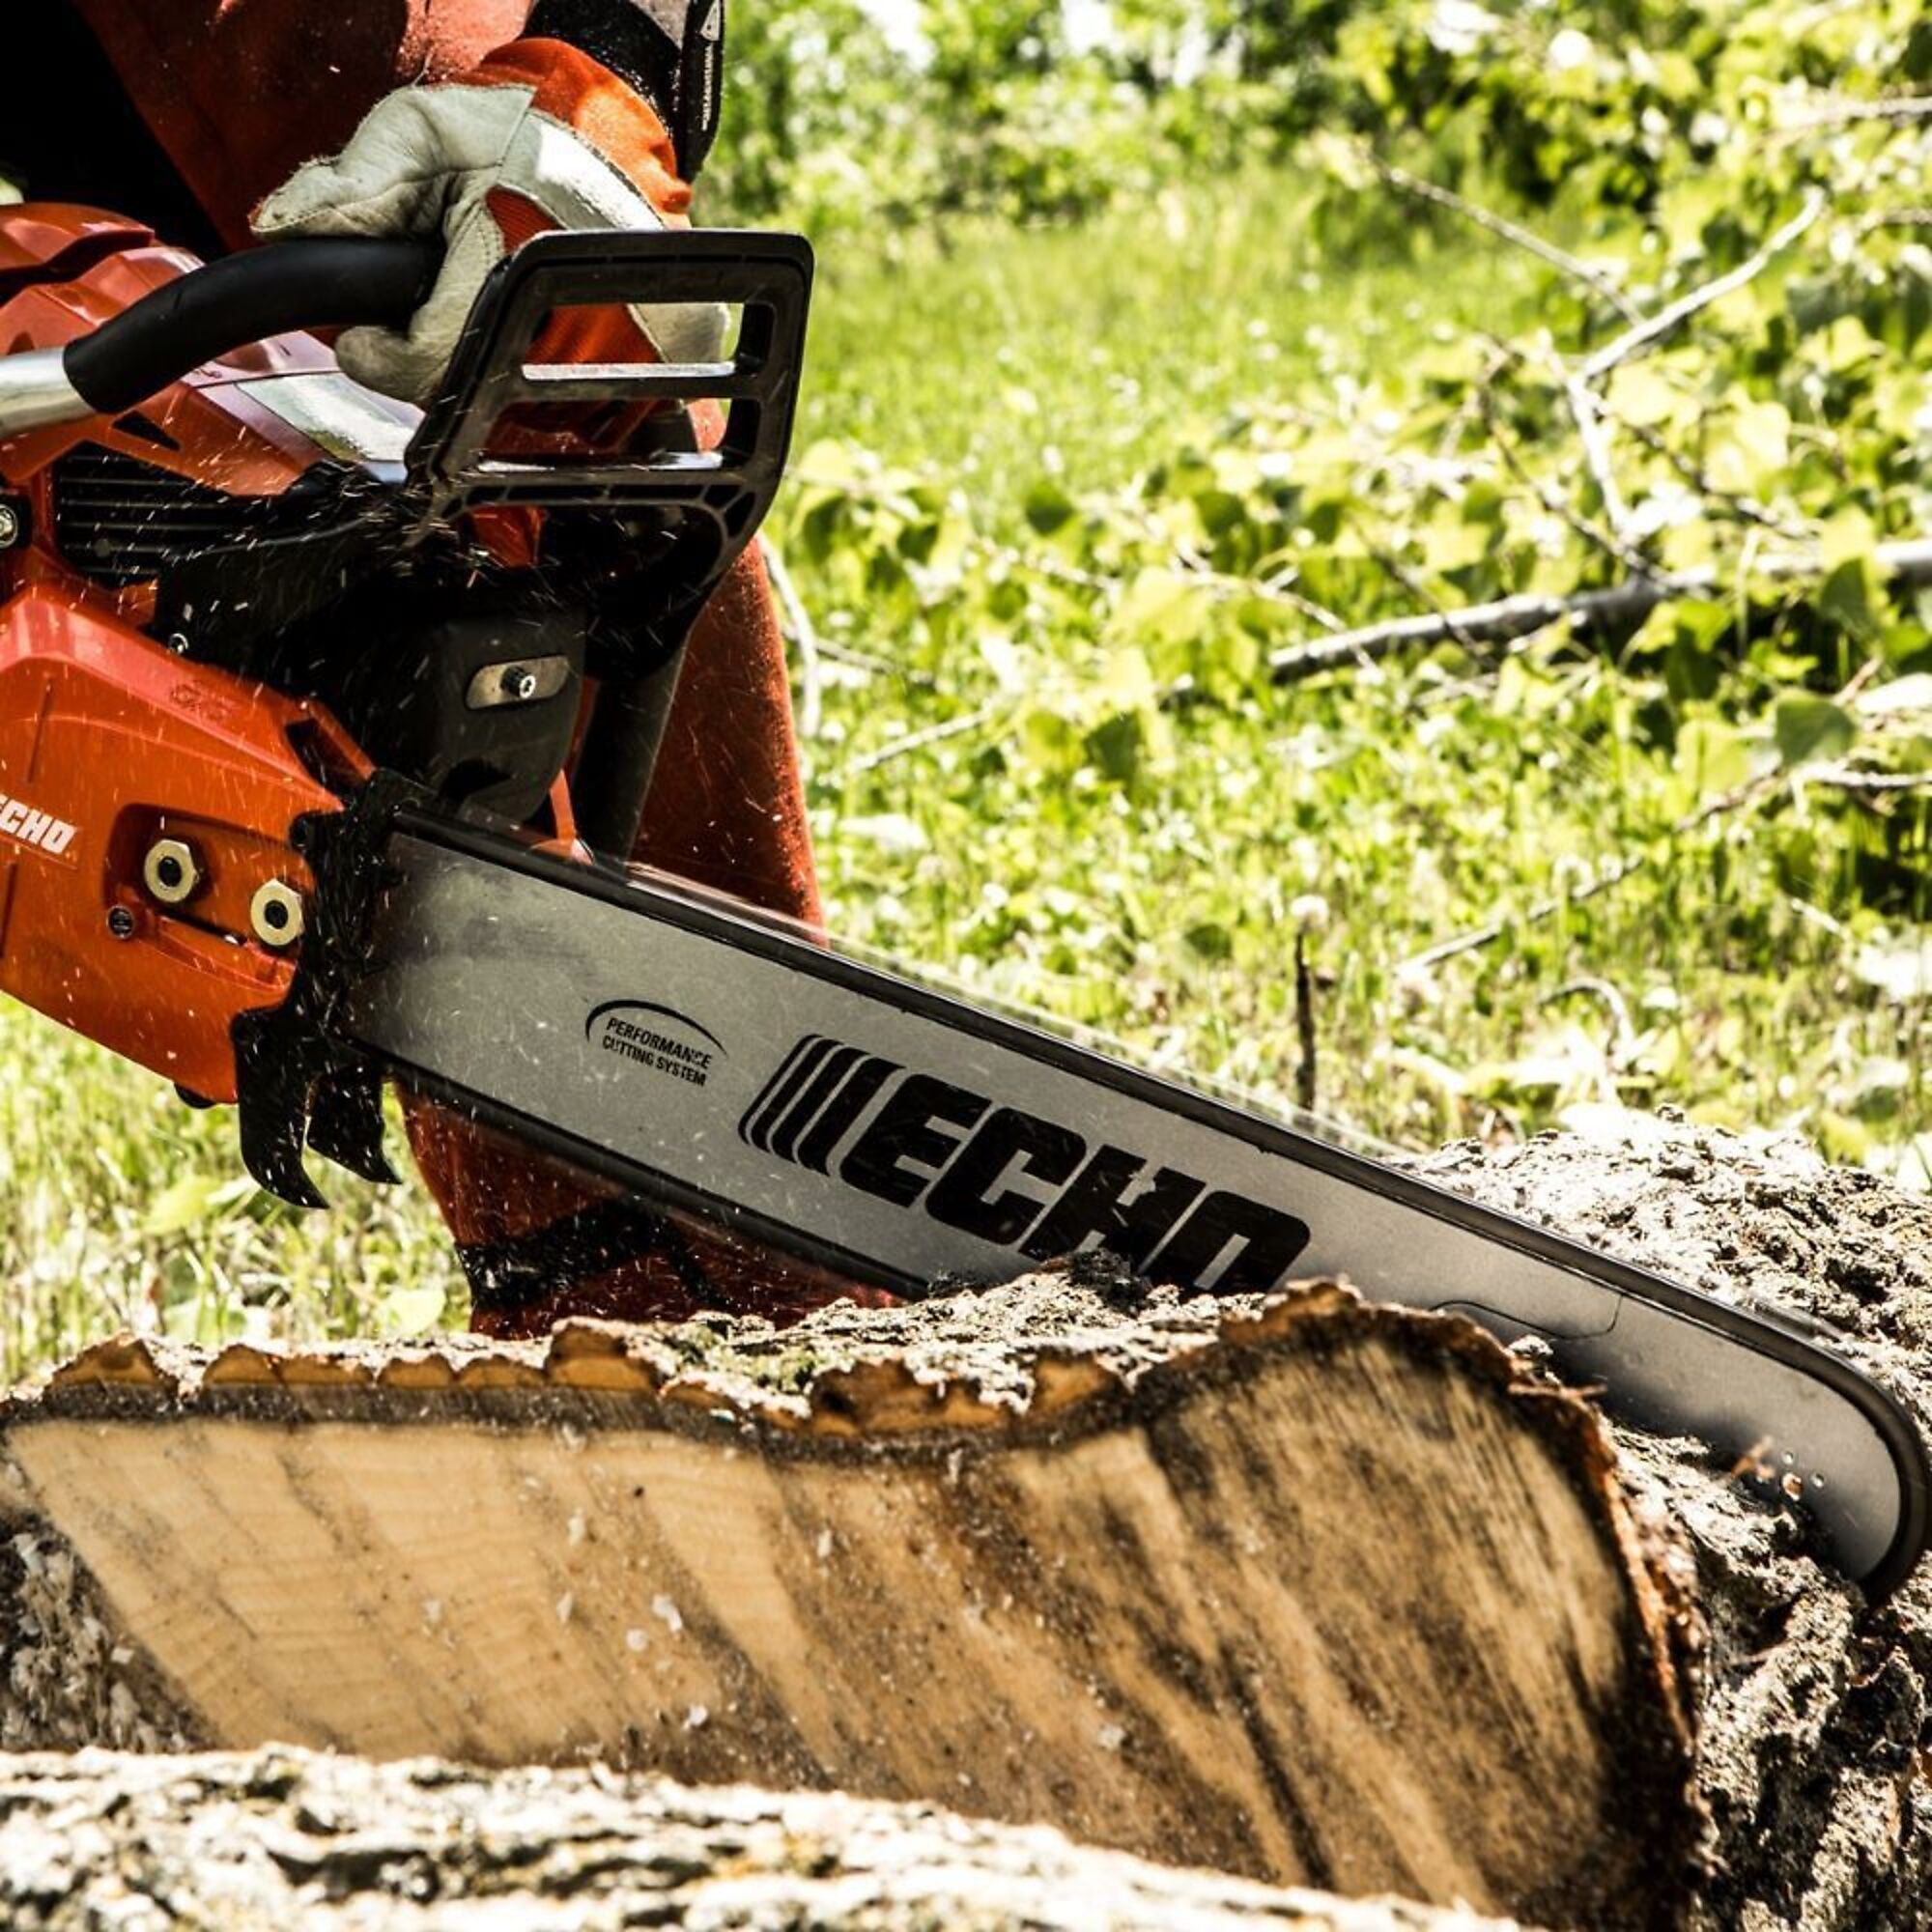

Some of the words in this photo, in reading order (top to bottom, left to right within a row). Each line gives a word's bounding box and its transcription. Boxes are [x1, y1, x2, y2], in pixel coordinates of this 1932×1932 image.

[603, 1035, 654, 1067] CUTTING
[656, 1056, 707, 1087] SYSTEM
[606, 1017, 712, 1069] PERFORMANCE
[840, 1073, 1311, 1300] ECHO
